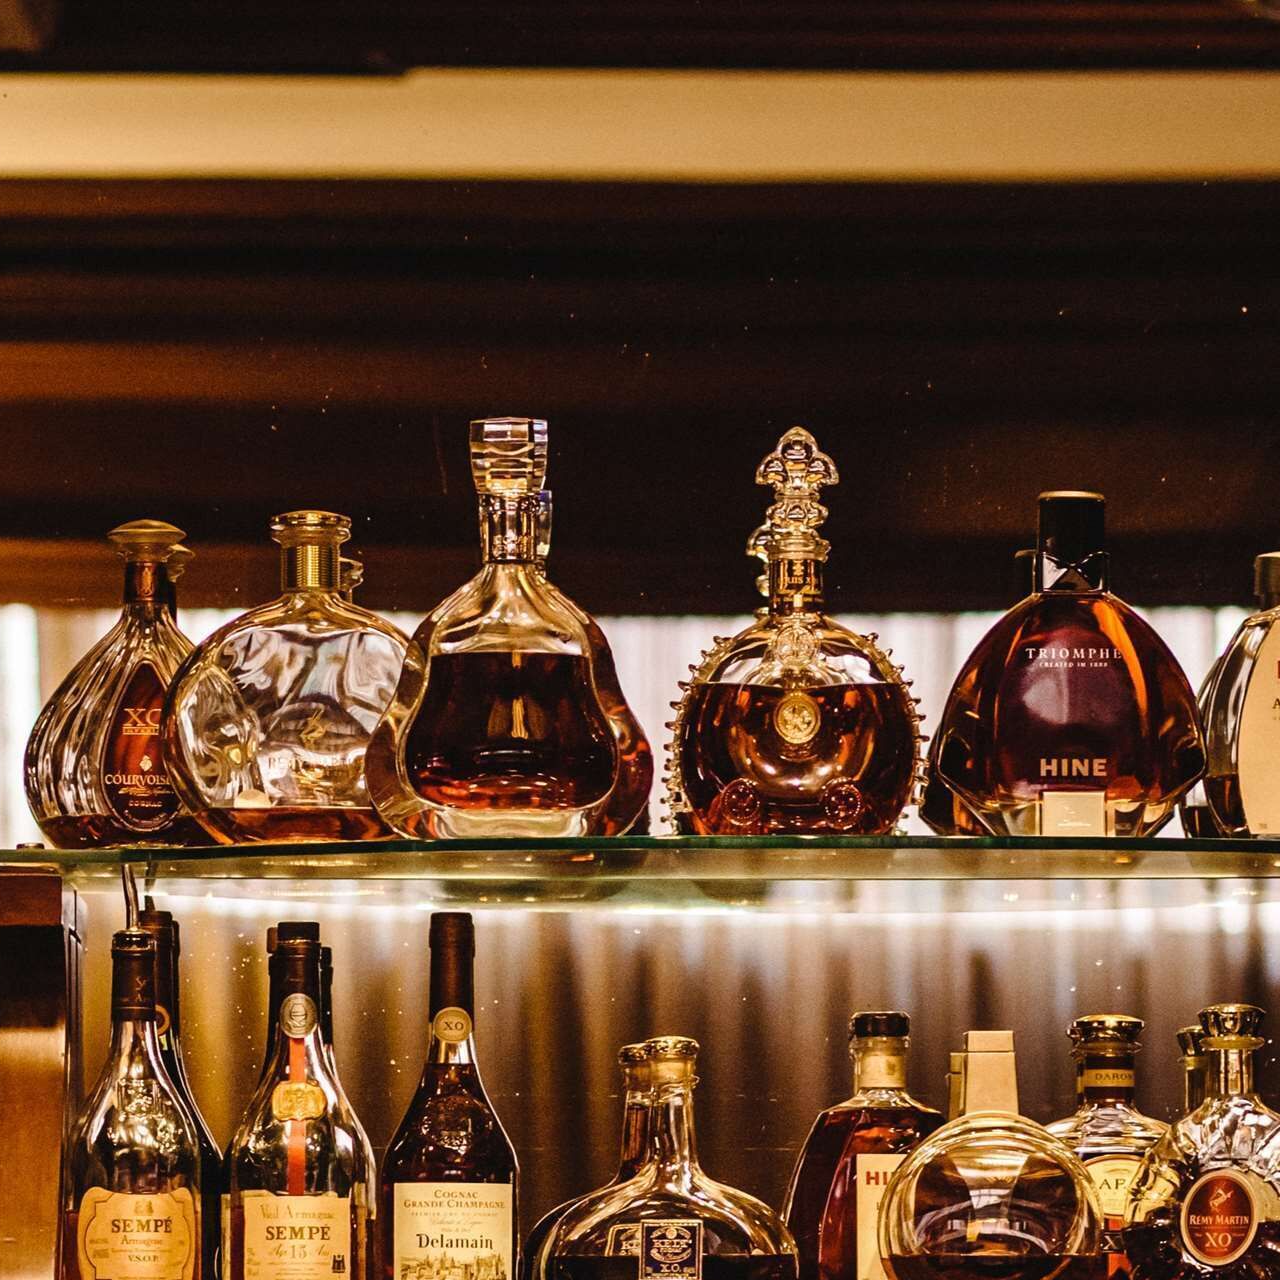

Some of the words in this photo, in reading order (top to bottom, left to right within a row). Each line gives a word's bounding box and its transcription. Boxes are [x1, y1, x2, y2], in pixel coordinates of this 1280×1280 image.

[1025, 647, 1123, 660] TRIOMPHE
[1039, 758, 1108, 777] HINE
[434, 1189, 479, 1199] COGNAC
[403, 1200, 444, 1209] GRANDE
[447, 1200, 506, 1209] CHAMPAGNE
[111, 1216, 173, 1234] SEMPÉ
[1215, 1214, 1249, 1225] MARTIN
[265, 1223, 331, 1241] SEMPÉ
[1204, 1231, 1232, 1248] XO
[416, 1234, 494, 1251] Delamain
